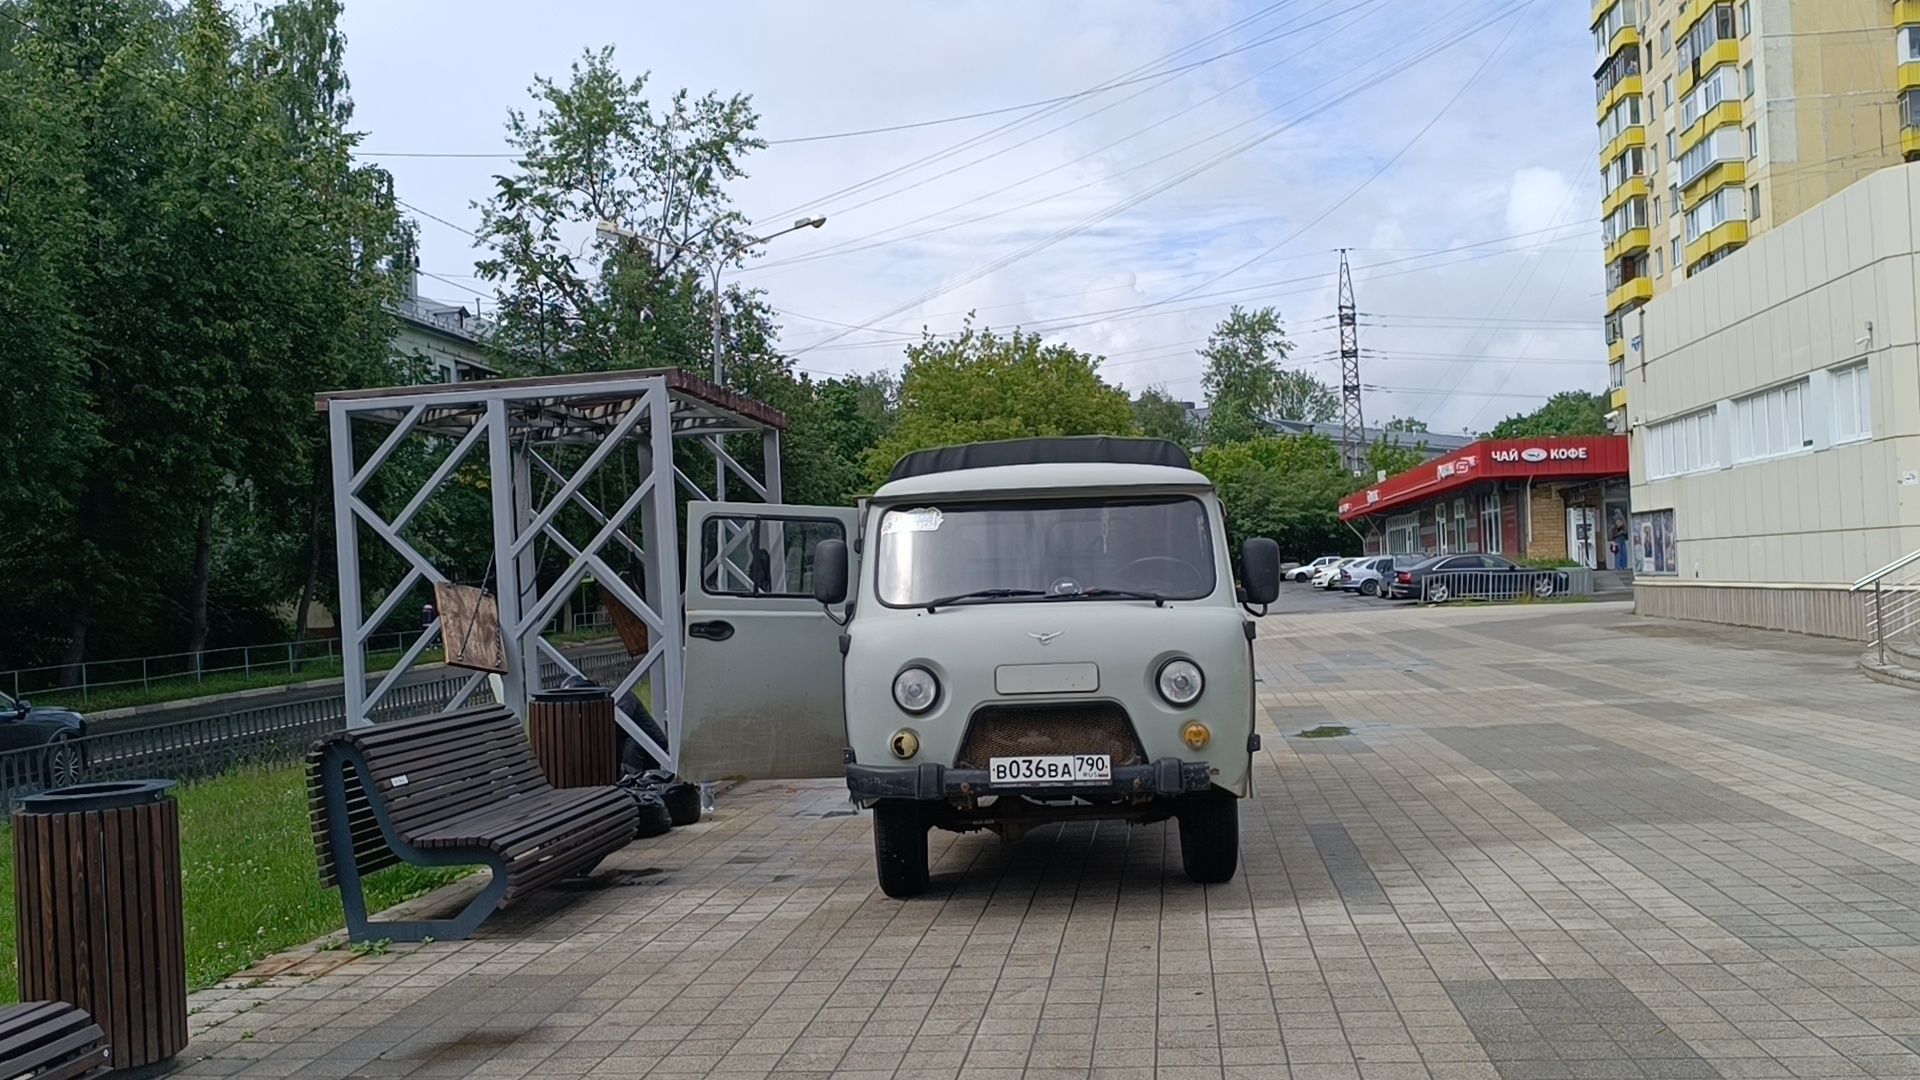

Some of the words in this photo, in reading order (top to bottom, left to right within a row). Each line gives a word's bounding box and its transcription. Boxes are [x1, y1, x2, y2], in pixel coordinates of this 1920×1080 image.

[1491, 448, 1519, 462] ЧАЙ
[1550, 447, 1588, 460] КОФЕ
[996, 759, 1072, 779] В036ВА
[1076, 757, 1105, 772] 790
